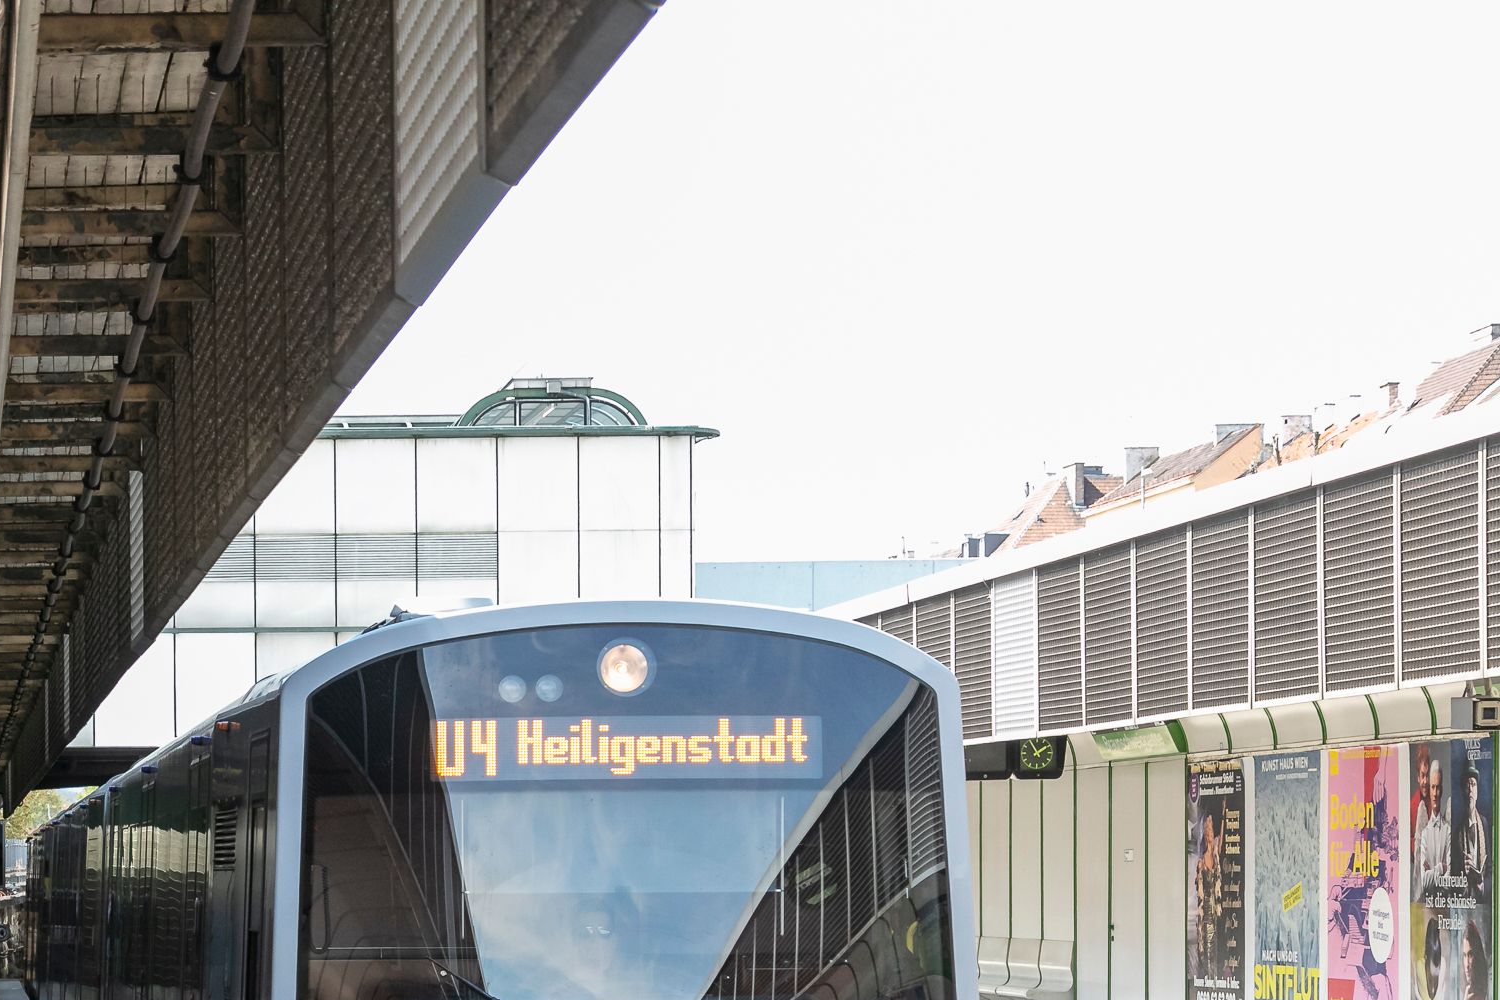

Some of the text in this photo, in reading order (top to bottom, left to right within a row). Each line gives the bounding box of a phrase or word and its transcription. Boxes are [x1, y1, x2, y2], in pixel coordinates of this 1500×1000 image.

[436, 718, 808, 776] U4 Heiligenstadt
[1280, 757, 1294, 770] HAUS
[1295, 756, 1309, 769] WIEN
[1330, 793, 1375, 830] Boden
[1329, 840, 1380, 880] für Alle
[1425, 893, 1477, 909] ist die schönste
[1262, 950, 1299, 962] NACH UNS DIE
